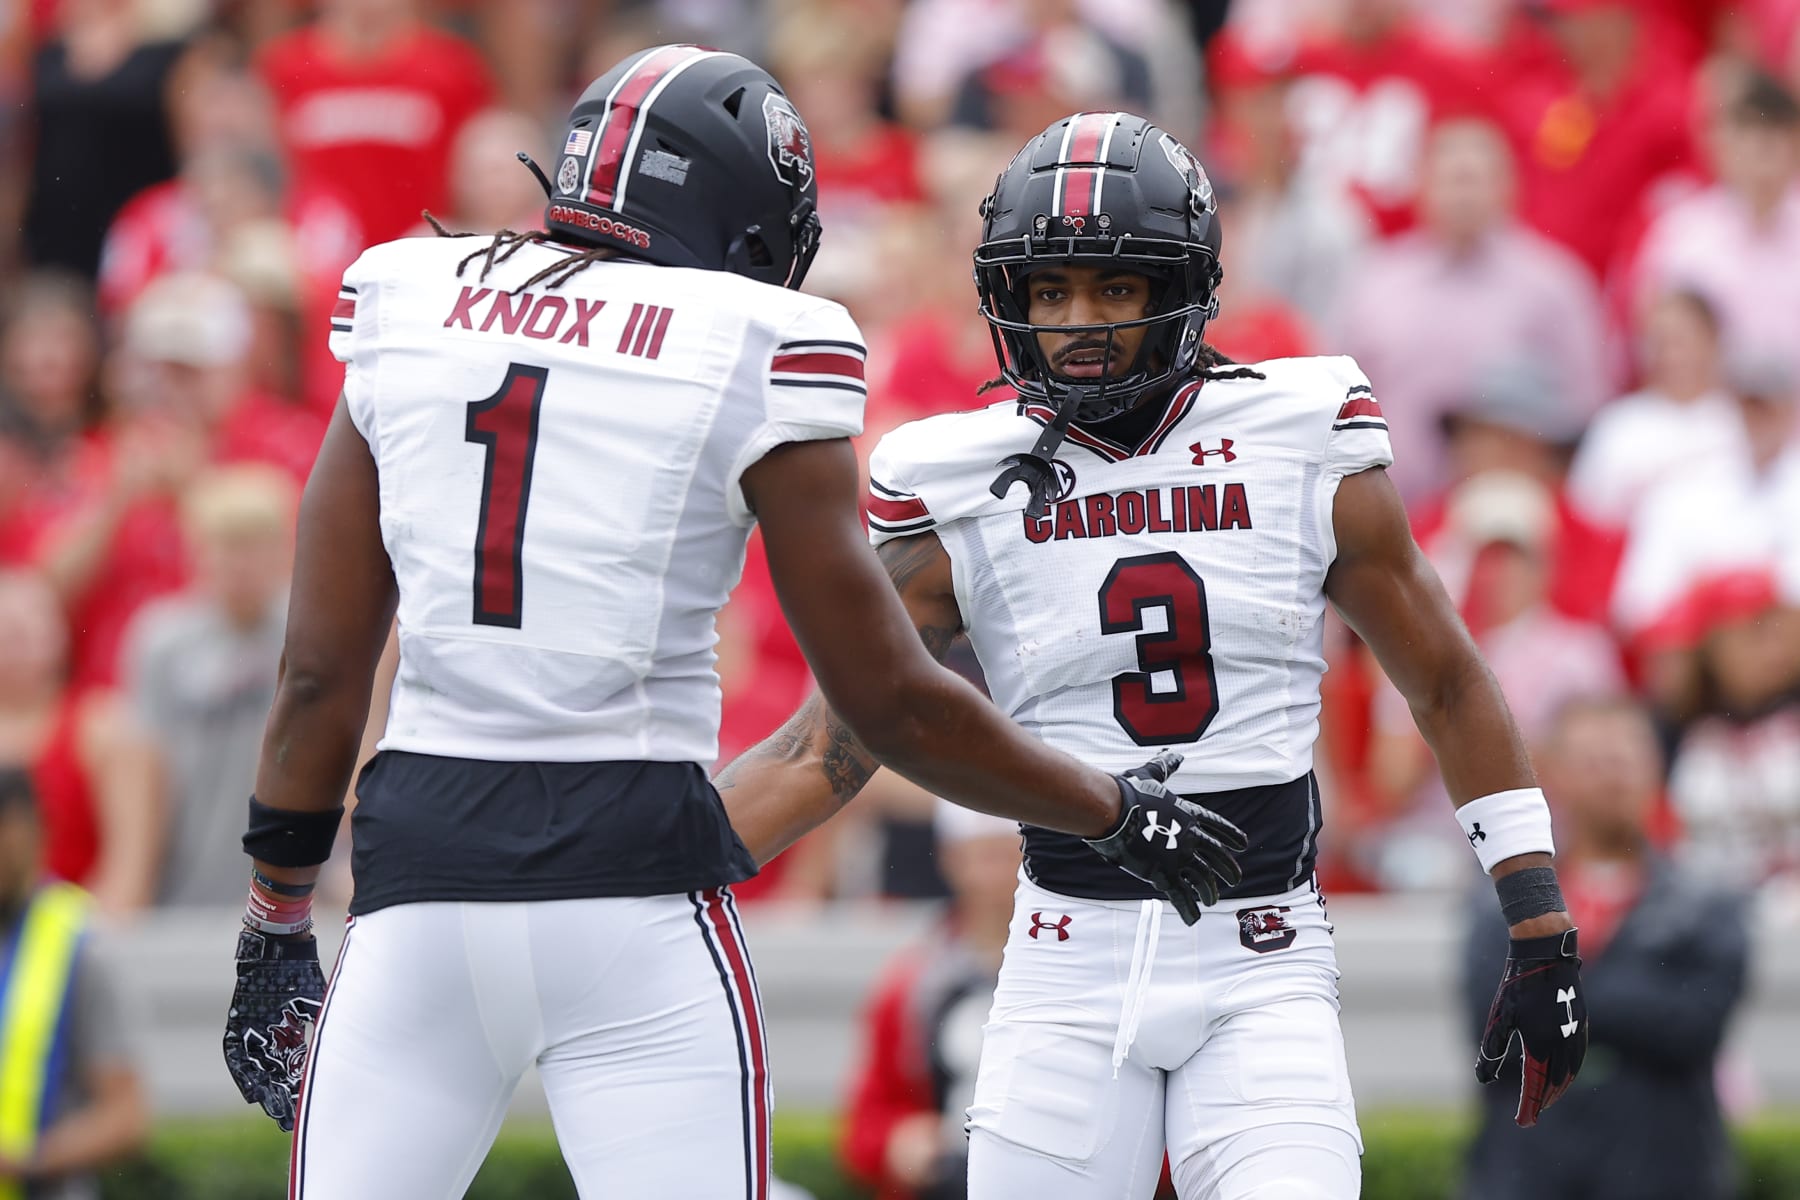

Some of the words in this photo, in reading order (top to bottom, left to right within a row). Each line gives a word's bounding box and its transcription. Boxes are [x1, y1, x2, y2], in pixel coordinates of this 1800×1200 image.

[549, 205, 652, 249] GAMECOCKS
[443, 286, 608, 348] KNOX
[616, 302, 675, 361] III
[465, 361, 550, 630] 1
[1023, 482, 1253, 545] CAROLINA
[1097, 550, 1220, 747] 3
